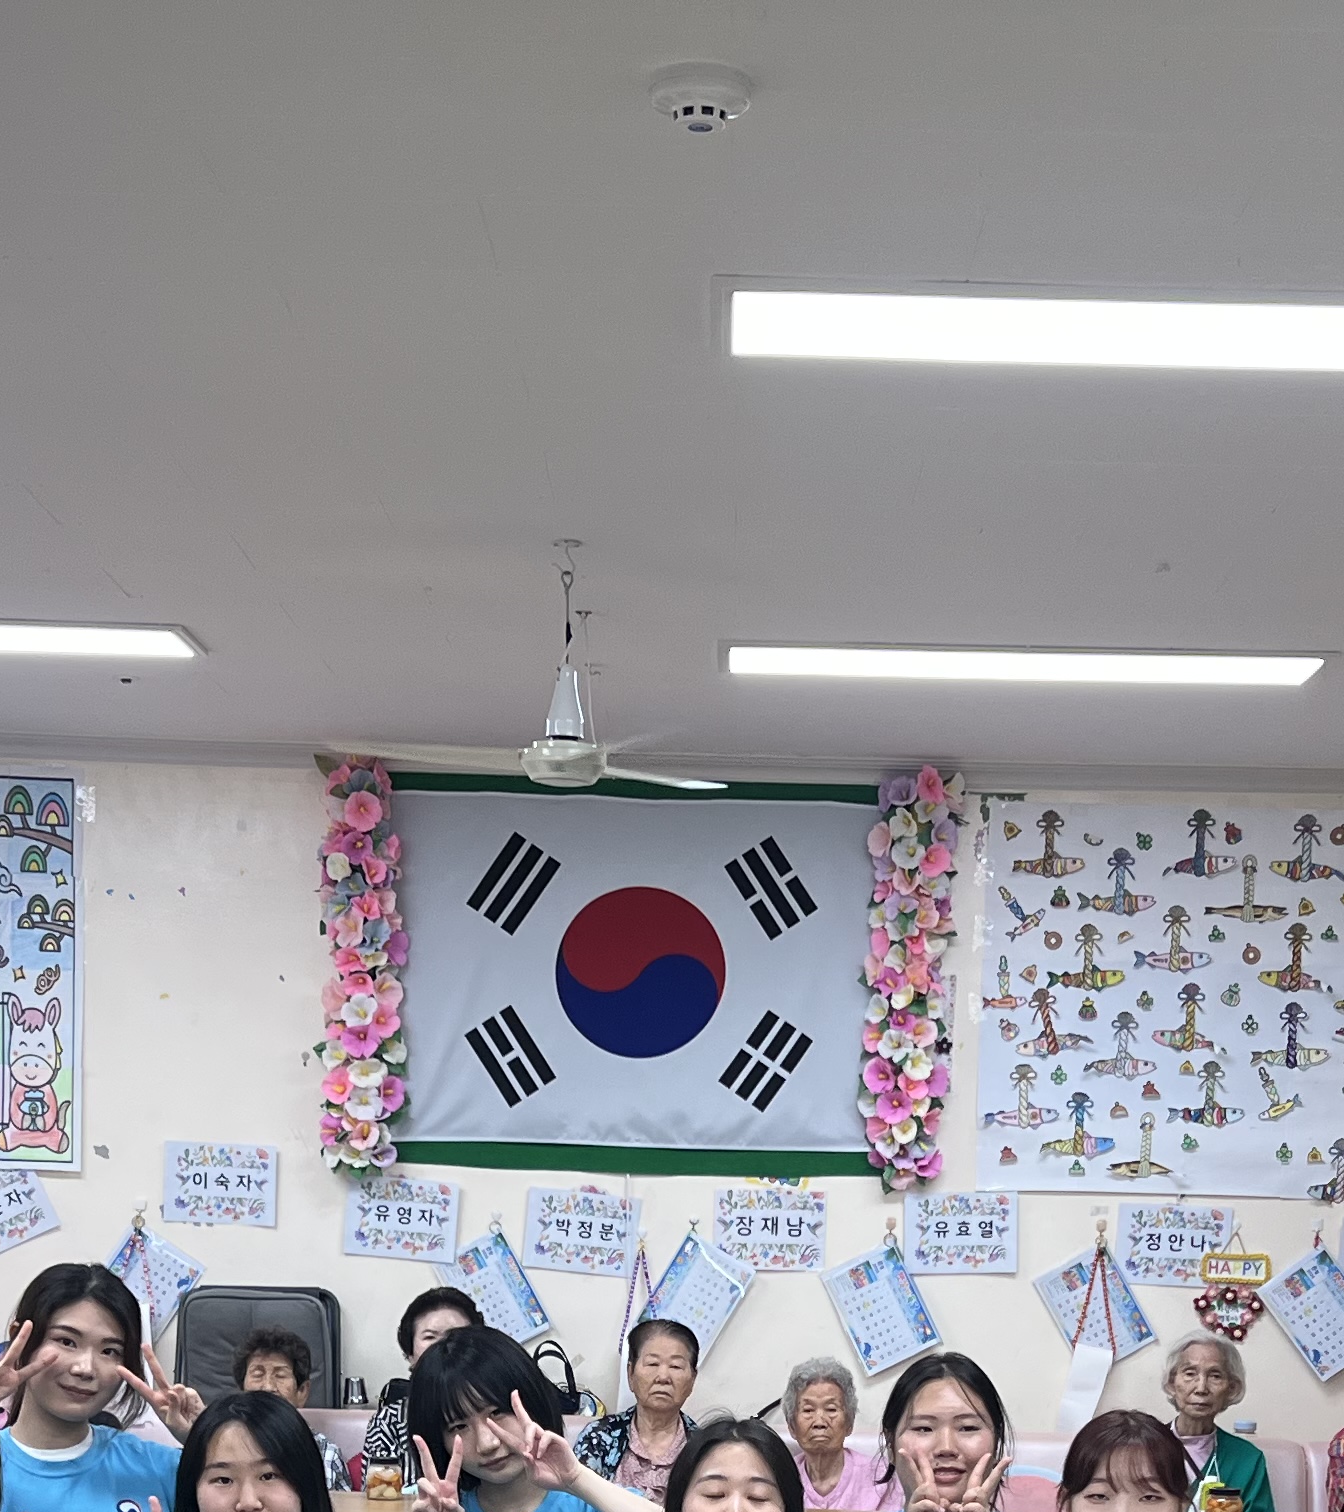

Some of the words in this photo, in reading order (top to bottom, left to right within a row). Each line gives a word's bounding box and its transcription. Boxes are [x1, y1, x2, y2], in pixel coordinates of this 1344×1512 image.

[192, 1172, 253, 1191] 이숙자
[374, 1204, 435, 1227] 유영자
[735, 1215, 806, 1237] 장재남
[555, 1218, 616, 1242] 박정분
[933, 1220, 994, 1239] 유효열
[1144, 1232, 1207, 1253] 정안나
[1208, 1261, 1263, 1276] HAPPY
